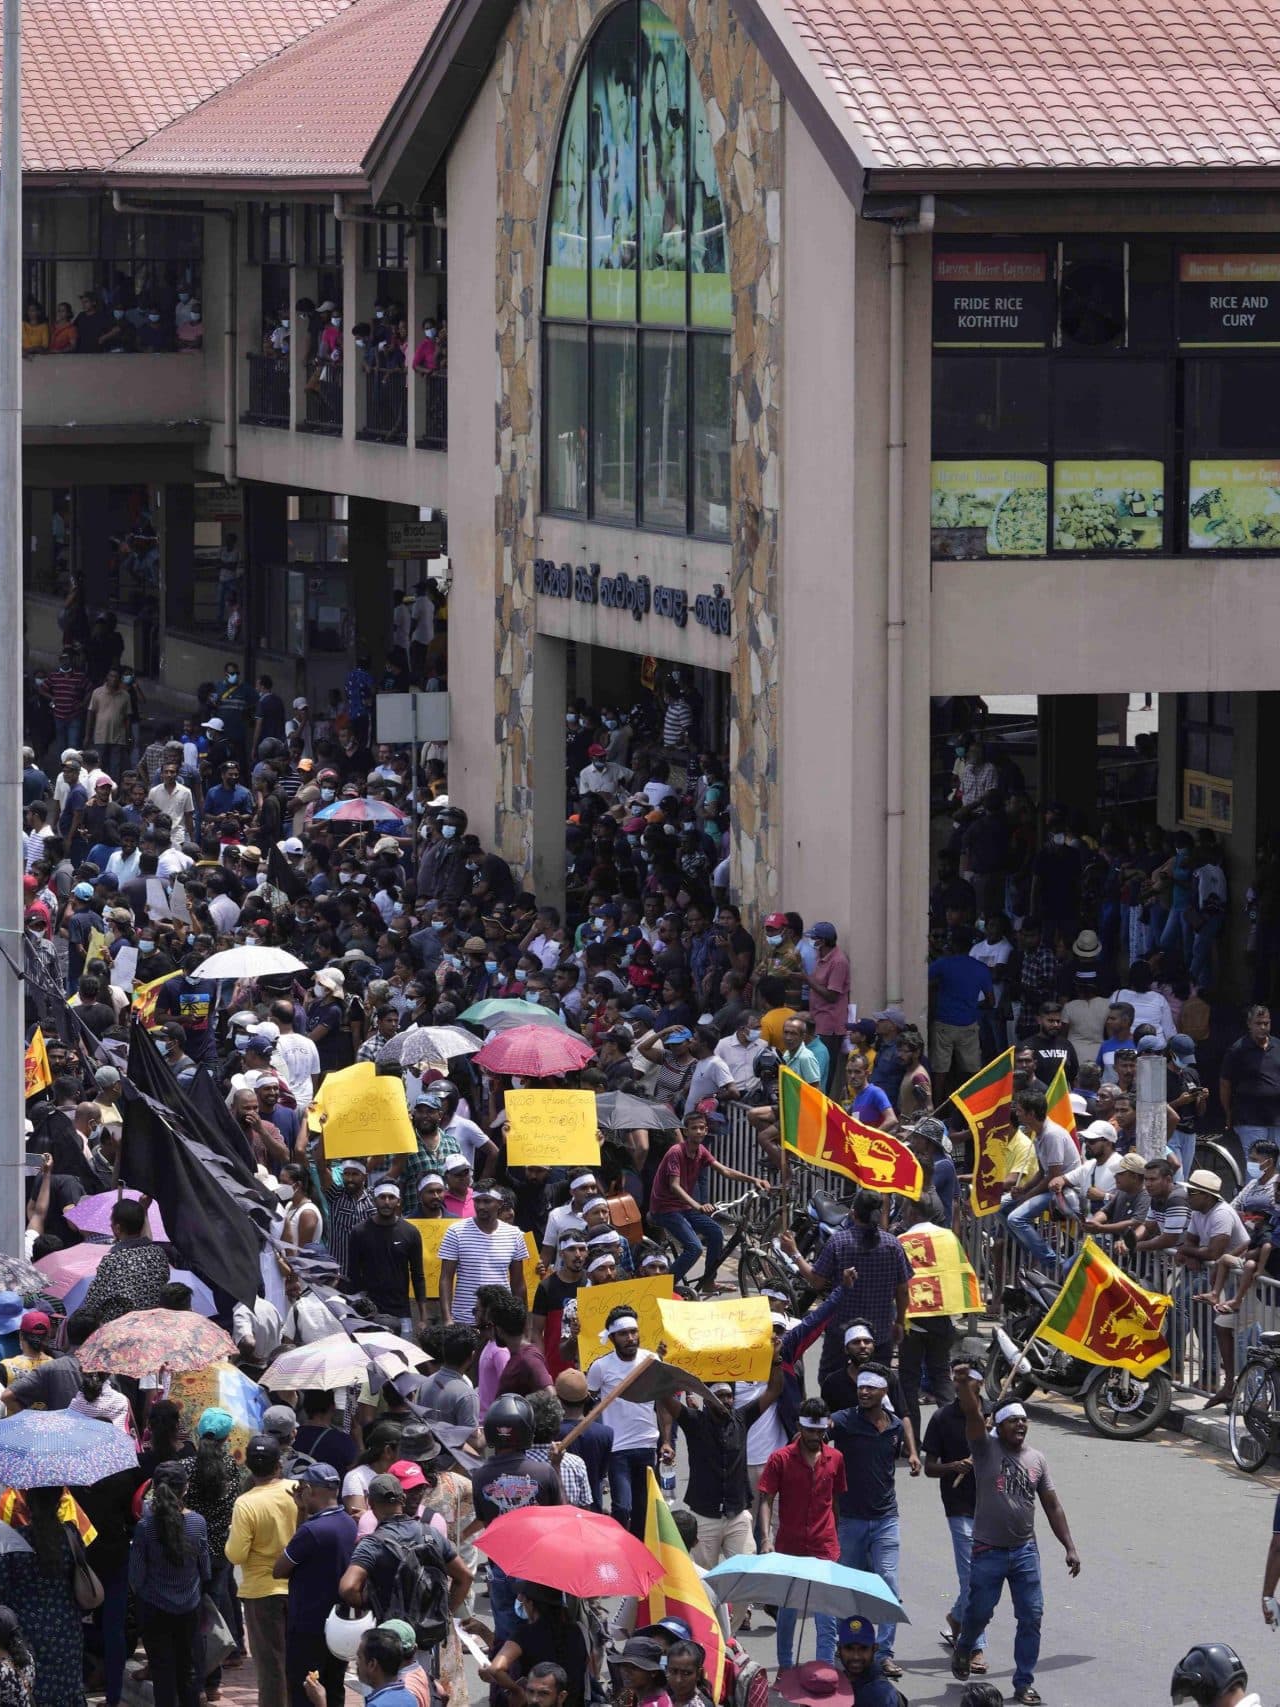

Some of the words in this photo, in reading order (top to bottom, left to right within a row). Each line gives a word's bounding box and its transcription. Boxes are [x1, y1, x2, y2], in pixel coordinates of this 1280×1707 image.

[954, 298, 990, 310] FRIDE
[995, 298, 1024, 310] RICE
[1210, 296, 1238, 309] RICE
[1241, 296, 1269, 309] AND
[958, 315, 1019, 328] KOTHTHU
[1222, 314, 1256, 327] CURY
